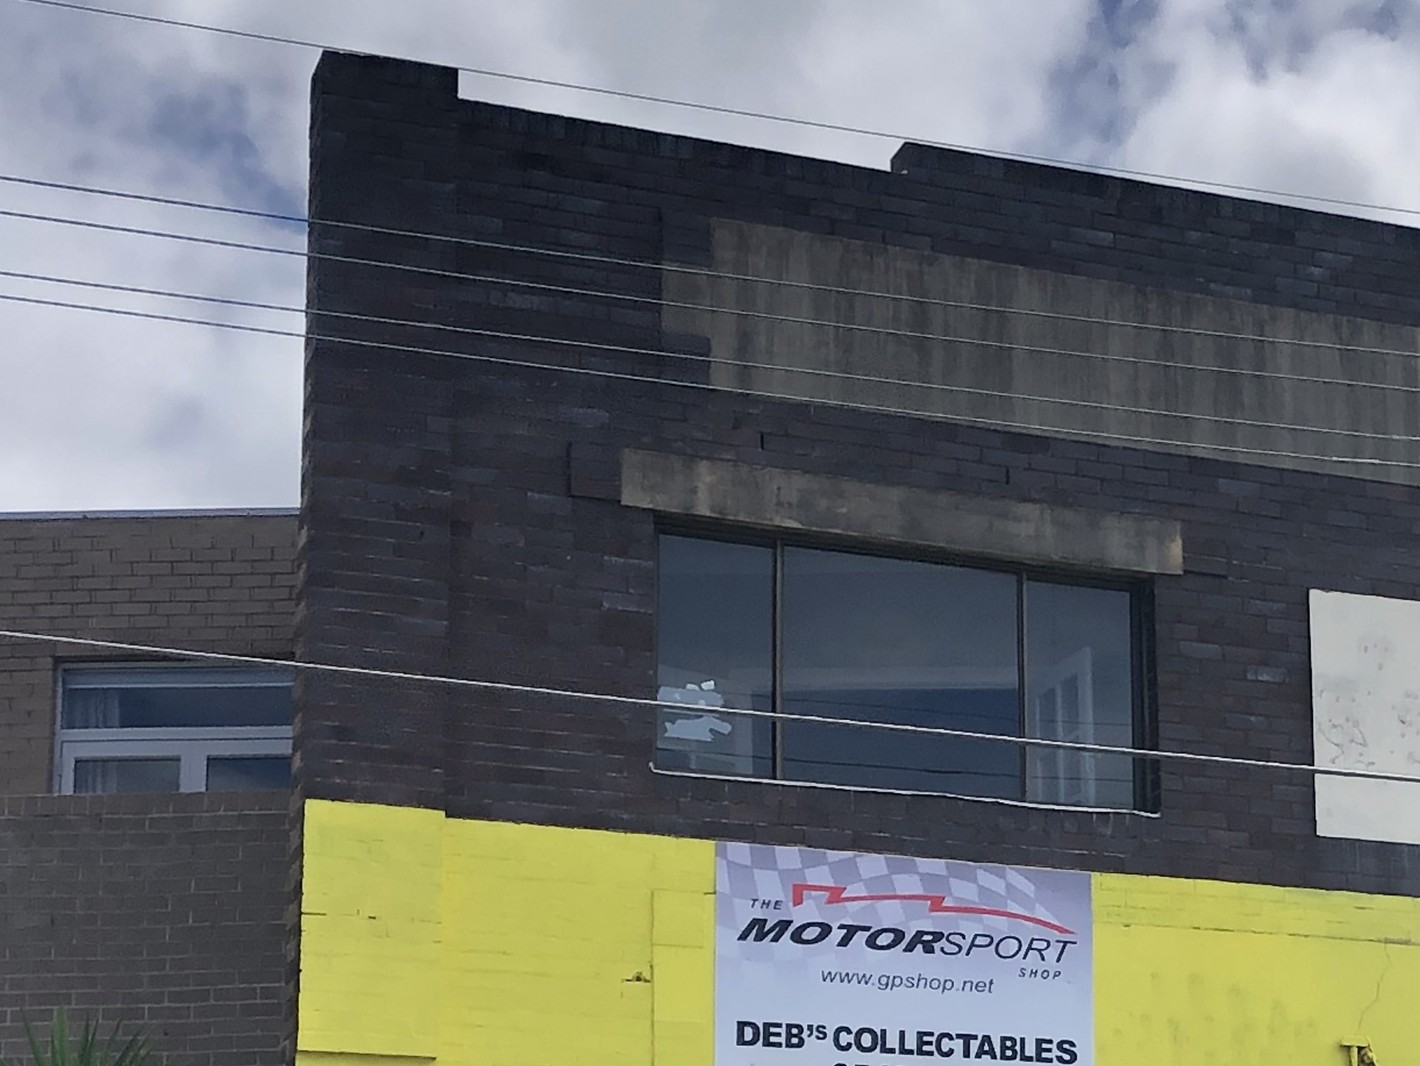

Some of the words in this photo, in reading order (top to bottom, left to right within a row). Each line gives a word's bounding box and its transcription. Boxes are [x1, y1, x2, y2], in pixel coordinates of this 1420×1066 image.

[750, 898, 783, 910] THE
[737, 917, 1078, 963] MOTORSPORT
[821, 969, 995, 994] www.gpshop.net
[1018, 967, 1062, 980] SHOP
[833, 1025, 1079, 1065] COLLECTABLES
